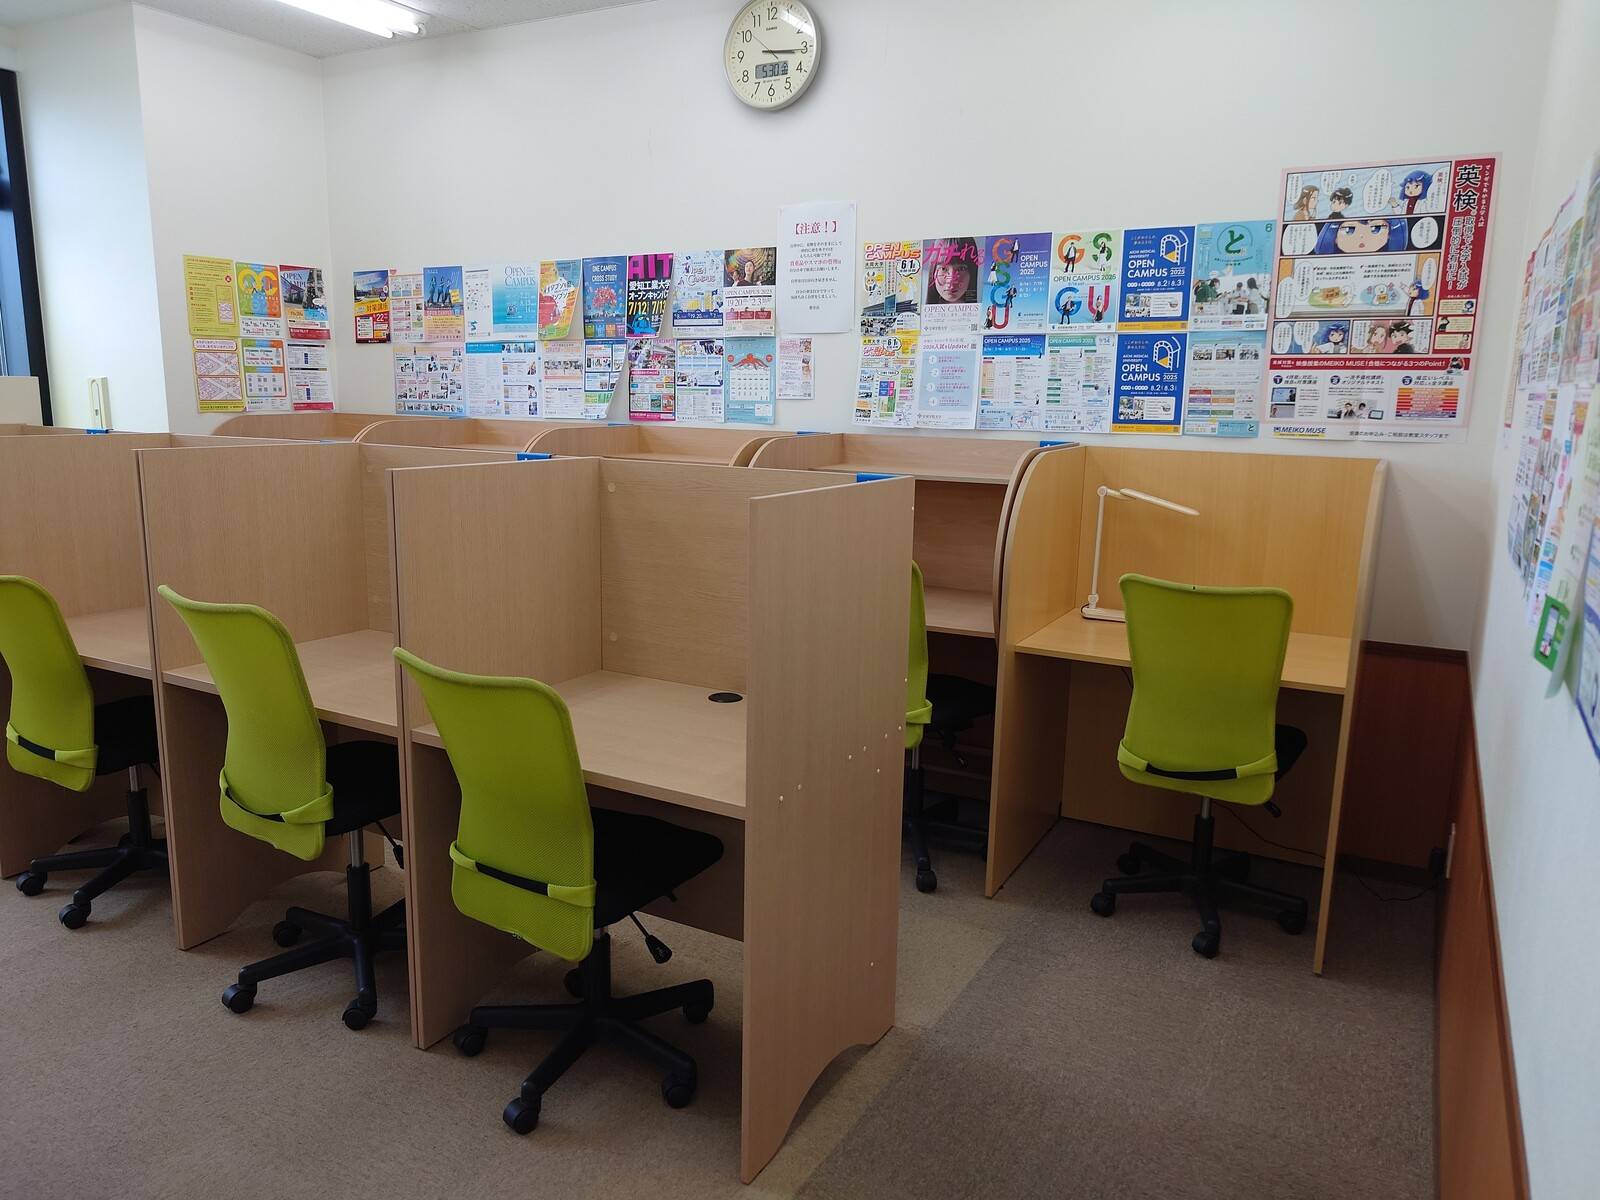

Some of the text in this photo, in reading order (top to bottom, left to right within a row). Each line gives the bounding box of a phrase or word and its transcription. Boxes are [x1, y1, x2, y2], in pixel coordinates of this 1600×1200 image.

[767, 6, 778, 20] 12
[753, 14, 761, 28] 11
[741, 29, 753, 43] 10
[800, 40, 808, 54] 3
[737, 50, 745, 63] 9
[795, 61, 803, 73] 4
[741, 69, 749, 83] 8
[754, 81, 761, 95] 7
[784, 76, 792, 90] 5
[767, 83, 776, 97] 6
[1453, 164, 1483, 213] 英検
[864, 242, 901, 253] OPEN
[1224, 229, 1245, 255] と
[864, 249, 921, 261] CAMPUS
[1020, 254, 1039, 262] OPEN
[628, 254, 673, 280] AIT
[1020, 261, 1048, 269] CAMPUS
[1128, 259, 1155, 269] OPEN
[1074, 274, 1101, 282] CAMPUS
[1127, 268, 1168, 278] CAMPUS
[628, 280, 671, 291] 愛知工業大学
[628, 302, 647, 315] 7/12
[924, 304, 979, 313] OPEN CAMPUS
[1121, 363, 1148, 372] OPEN
[1121, 373, 1161, 382] CAMPUS
